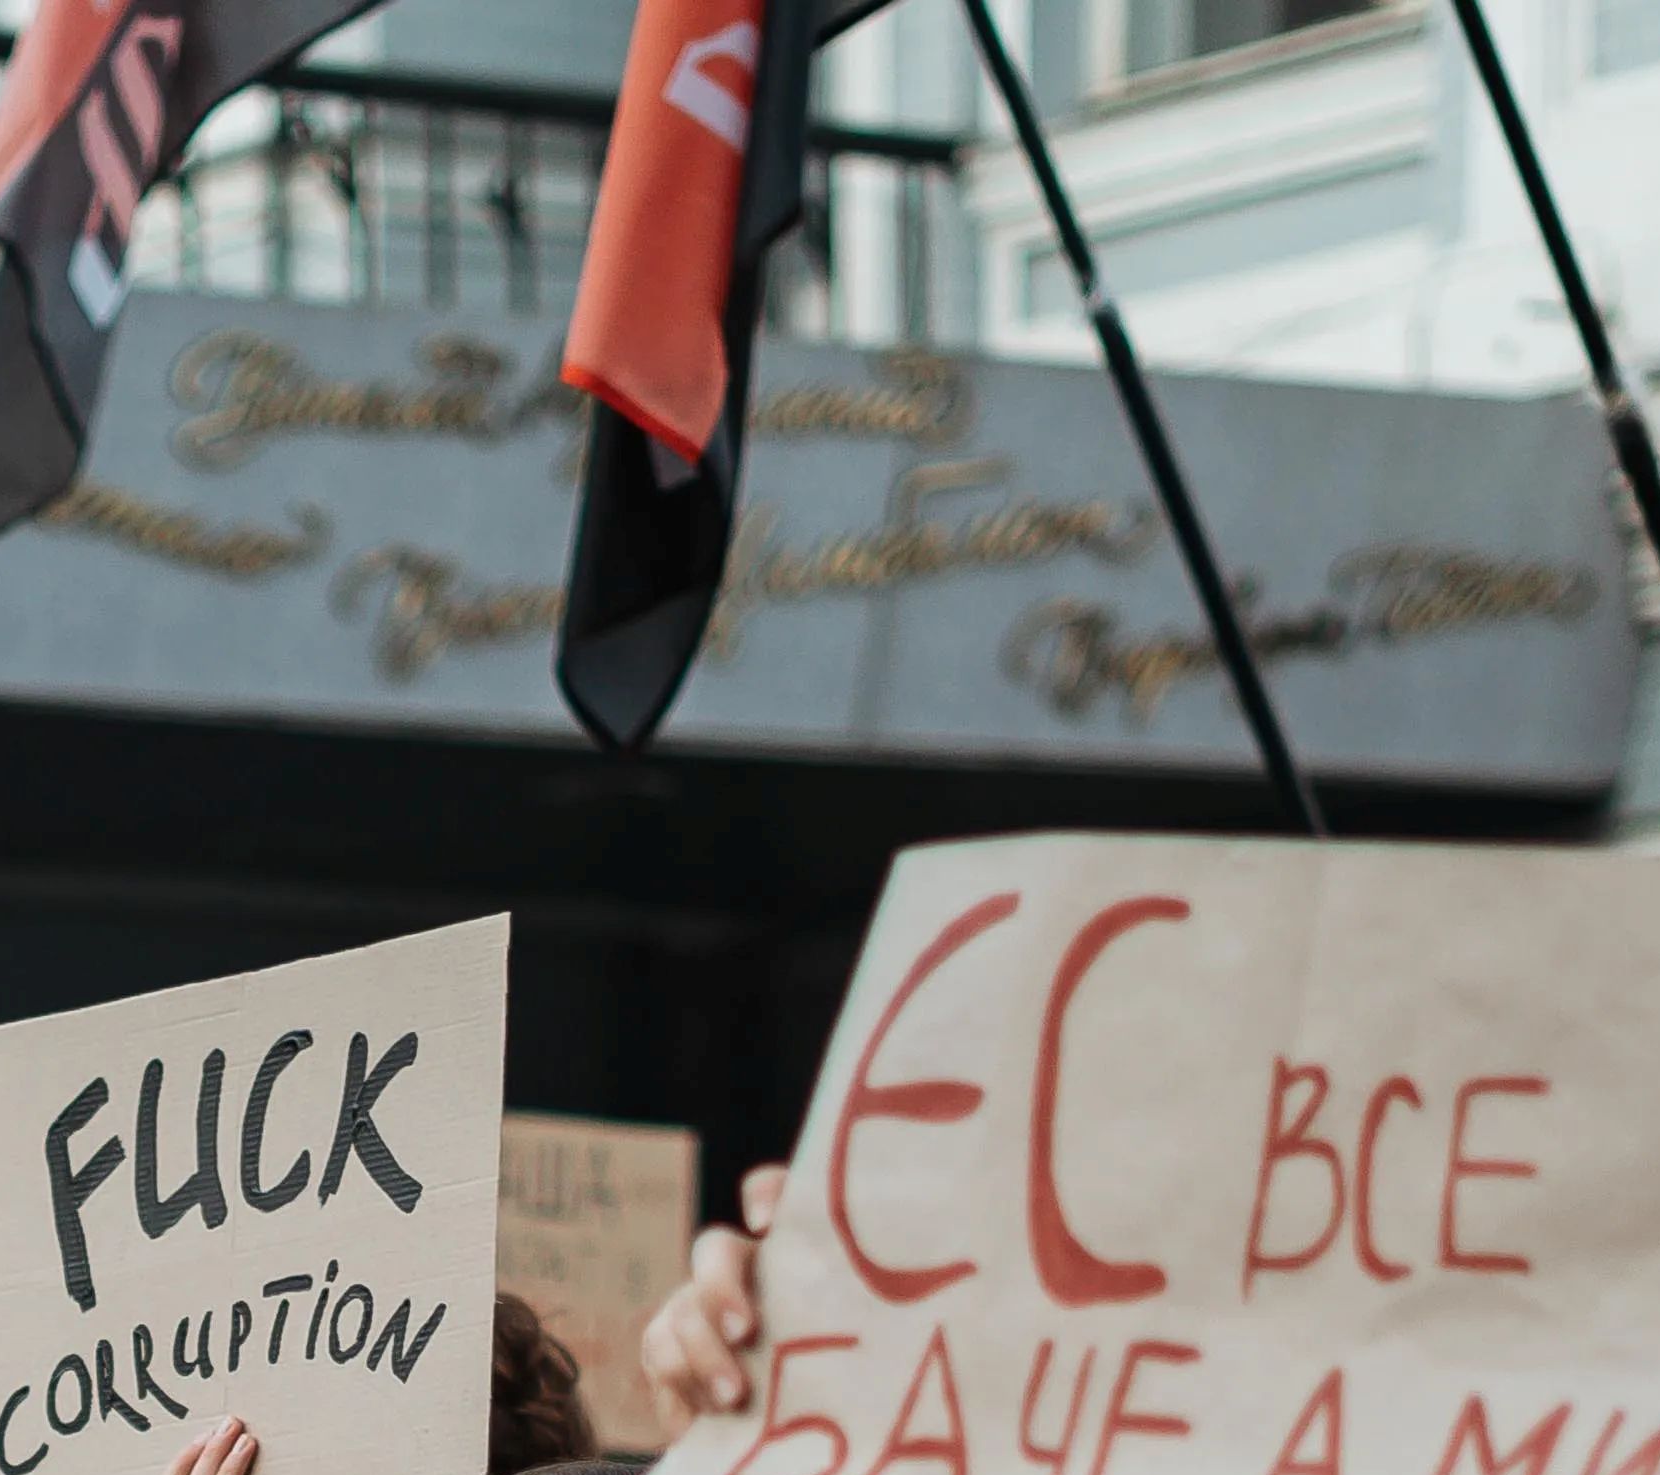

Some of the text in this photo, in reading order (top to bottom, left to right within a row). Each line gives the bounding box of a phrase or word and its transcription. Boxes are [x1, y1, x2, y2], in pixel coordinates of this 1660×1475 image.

[45, 1028, 424, 1313] FUCK
[827, 890, 1196, 1309] ЄС
[1240, 1053, 1554, 1300] ВСЕ
